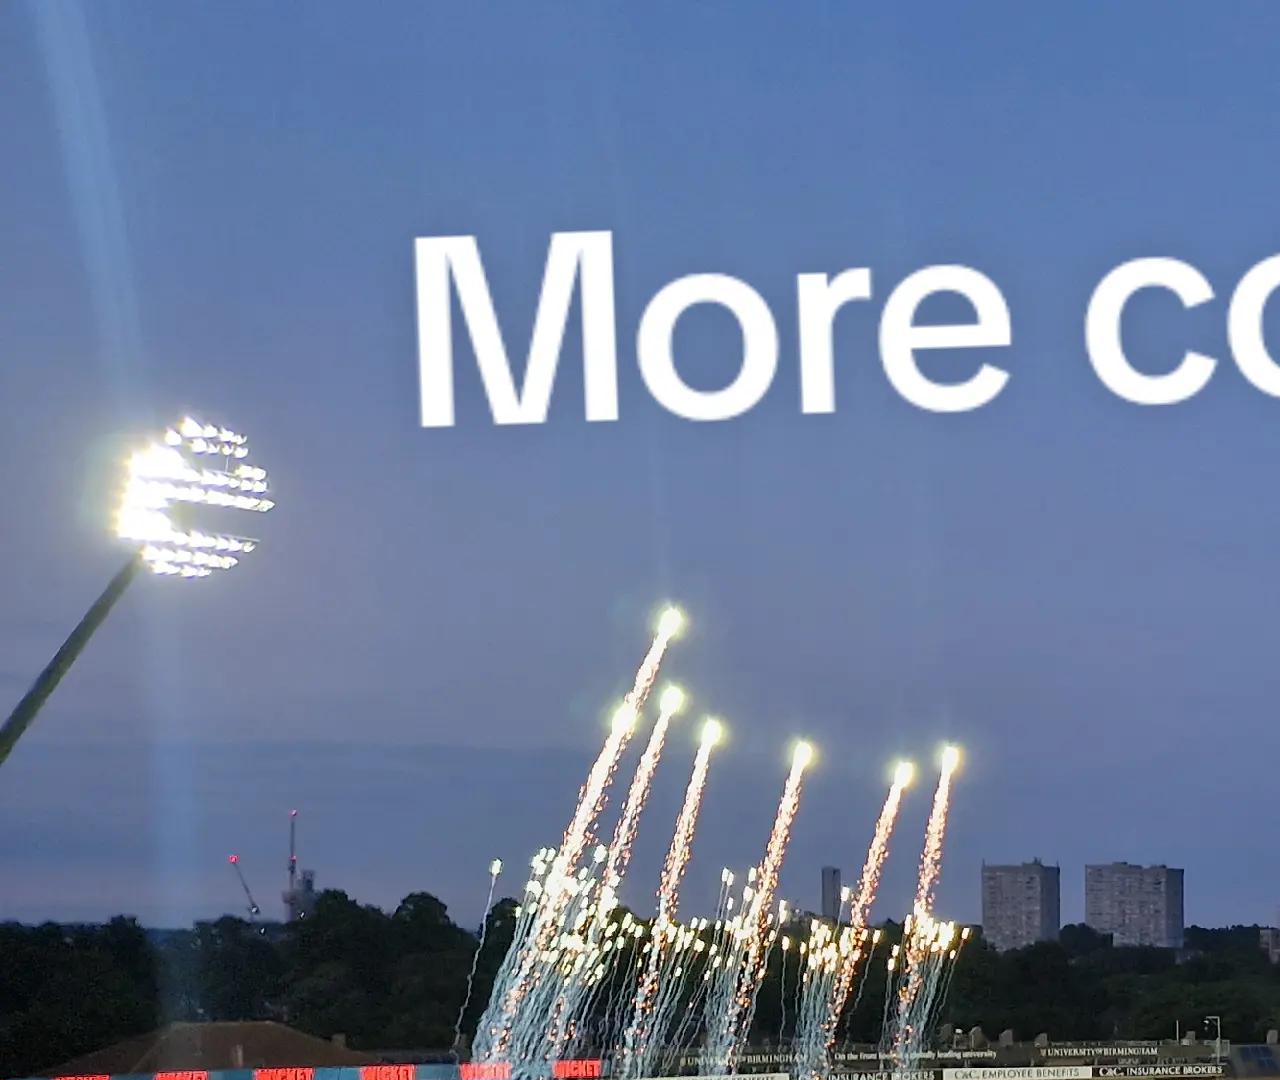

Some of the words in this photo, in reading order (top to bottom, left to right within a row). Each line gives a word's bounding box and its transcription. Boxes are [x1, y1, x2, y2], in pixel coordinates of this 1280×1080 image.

[554, 1058, 602, 1079] WICKET
[981, 1068, 1033, 1079] EMPLOYEE
[1036, 1067, 1080, 1078] BENEFITS
[1126, 1065, 1181, 1076] INSURANCE
[1183, 1063, 1223, 1075] BROKERS
